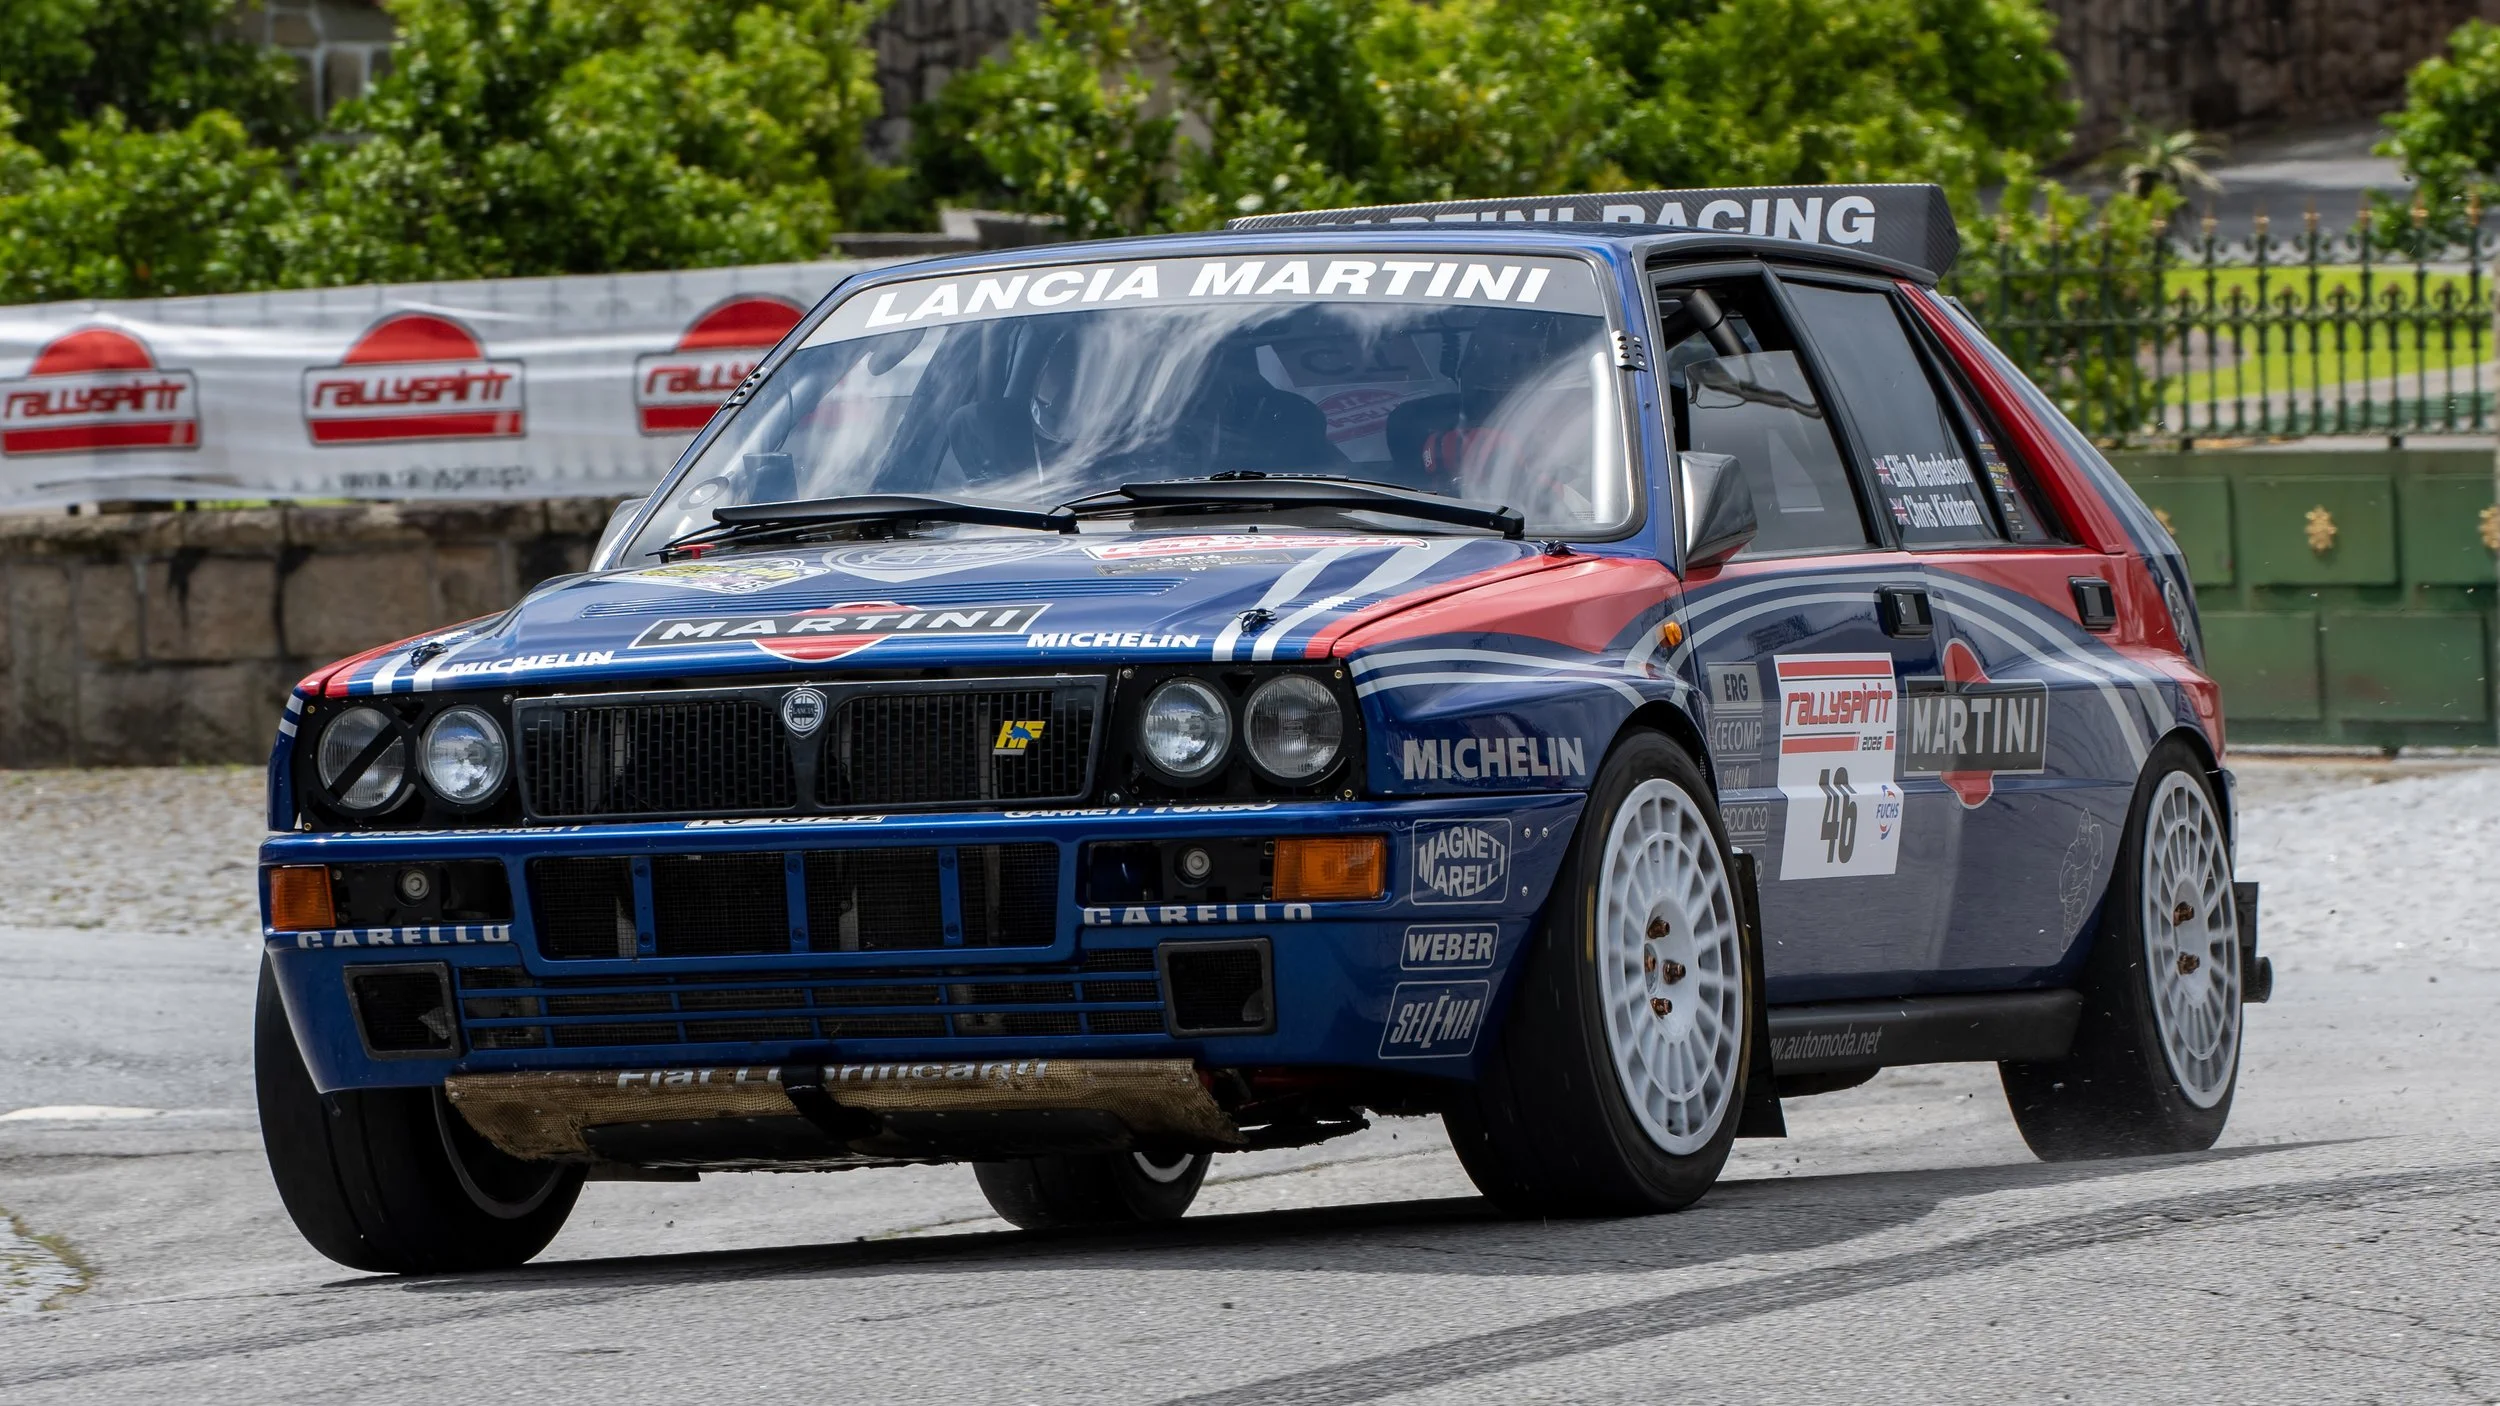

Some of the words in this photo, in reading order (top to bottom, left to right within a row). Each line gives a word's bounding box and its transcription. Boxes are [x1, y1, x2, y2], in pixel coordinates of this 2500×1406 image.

[864, 264, 1161, 330] LANCIA
[1187, 258, 1552, 303] MARTINI
[1884, 454, 1916, 488] Ellis
[1905, 451, 1974, 488] Mendelson
[1902, 494, 1939, 529] Chris
[1929, 493, 1983, 527] Kirkham
[658, 609, 1022, 640] MARTINI
[1027, 632, 1201, 650] MICHELIN
[448, 650, 614, 676] MICHELIN
[1723, 673, 1749, 702] ERG
[1785, 682, 1893, 726] rallyspirit
[995, 721, 1046, 749] HF
[1713, 719, 1762, 751] CECOMP
[1912, 697, 2039, 755] MARTINI
[1402, 737, 1587, 779] MICHELIN
[1861, 736, 1883, 751] 2026
[1721, 803, 1769, 832] sparco
[1818, 766, 1858, 864] 46
[1876, 802, 1900, 819] FUCHS
[297, 925, 510, 950] CARELLO
[1408, 932, 1493, 962] WEBER
[1770, 1023, 1883, 1061] w.automoda.net
